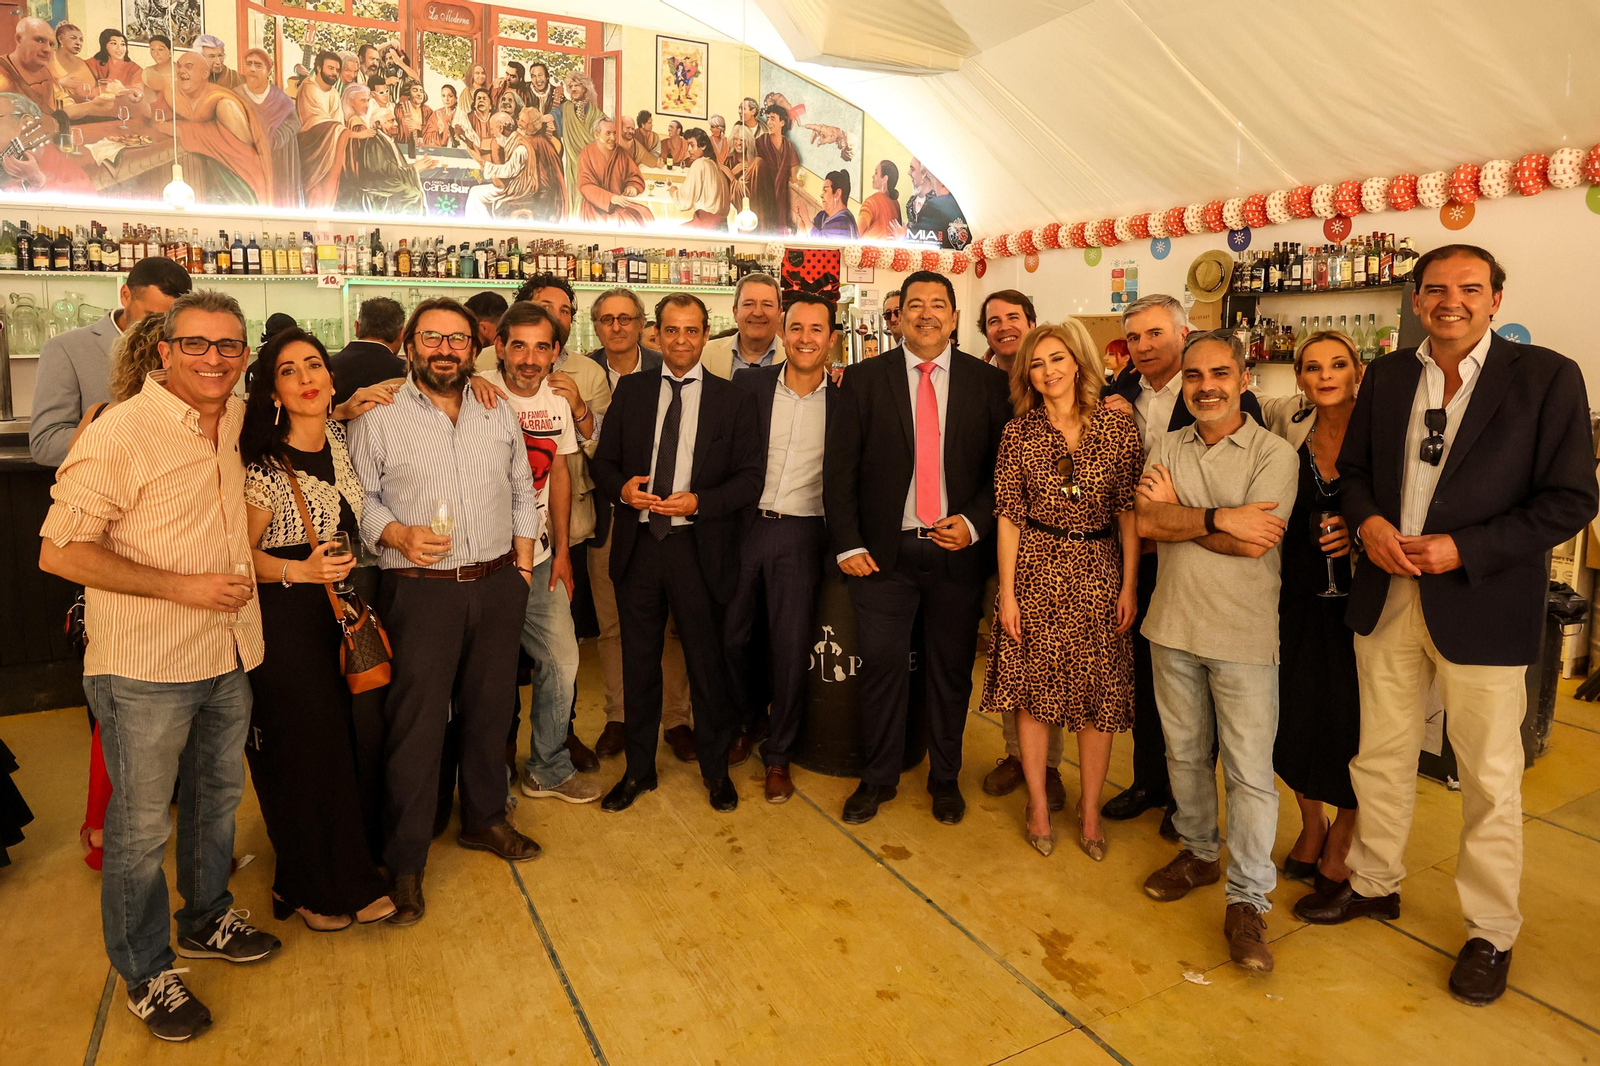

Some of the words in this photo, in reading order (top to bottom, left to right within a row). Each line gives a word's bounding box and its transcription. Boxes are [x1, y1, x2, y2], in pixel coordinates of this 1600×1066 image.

[428, 6, 439, 20] La
[440, 9, 470, 24] Moderna
[423, 181, 470, 193] CanalSur
[906, 229, 938, 240] MIA
